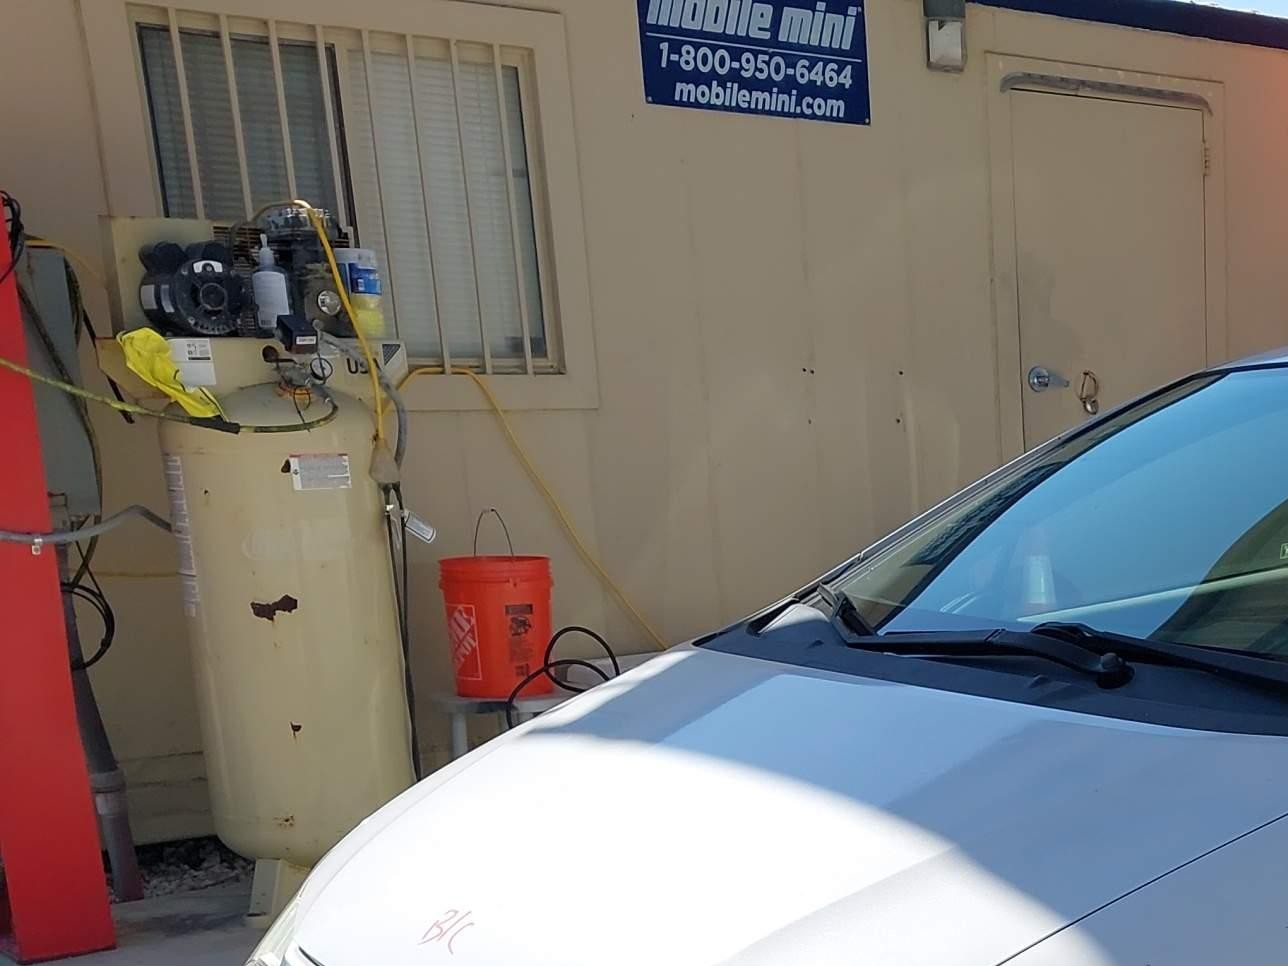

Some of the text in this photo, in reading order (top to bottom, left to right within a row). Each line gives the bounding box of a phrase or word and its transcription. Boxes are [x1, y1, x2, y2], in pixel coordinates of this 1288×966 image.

[778, 1, 857, 50] mini
[659, 42, 853, 89] 1-800-950-6464
[674, 80, 845, 118] mobilemini.com
